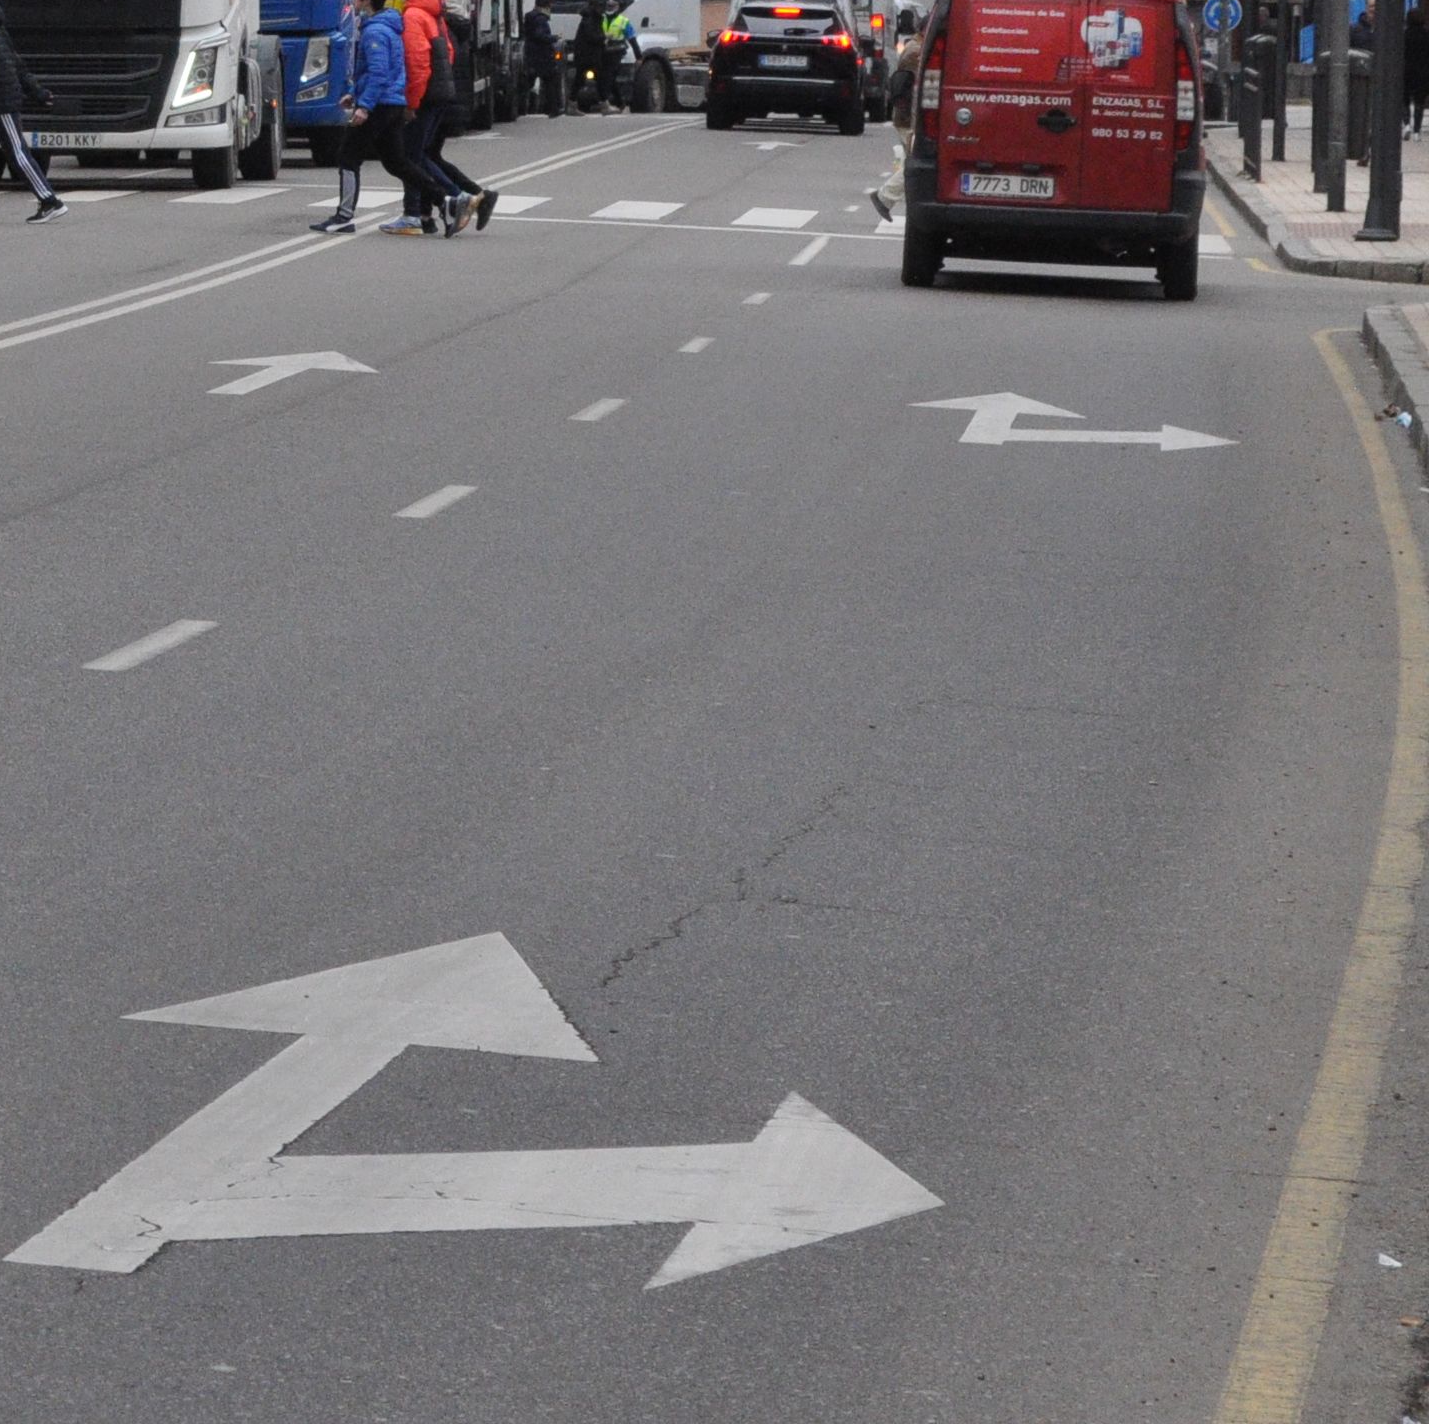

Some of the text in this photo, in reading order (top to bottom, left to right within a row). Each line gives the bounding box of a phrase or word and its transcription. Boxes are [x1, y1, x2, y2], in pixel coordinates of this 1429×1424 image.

[982, 8, 1036, 17] Instalaciones
[1037, 9, 1047, 17] de
[981, 26, 1028, 35] Calefacción
[980, 45, 1040, 55] Mantenimiento
[954, 93, 1072, 106] www.enzagas.com
[1092, 128, 1112, 138] 980
[1116, 129, 1129, 138] 53
[1133, 130, 1146, 139] 29
[41, 134, 97, 146] 8201 KKY
[972, 176, 1050, 194] 7773 DRN
